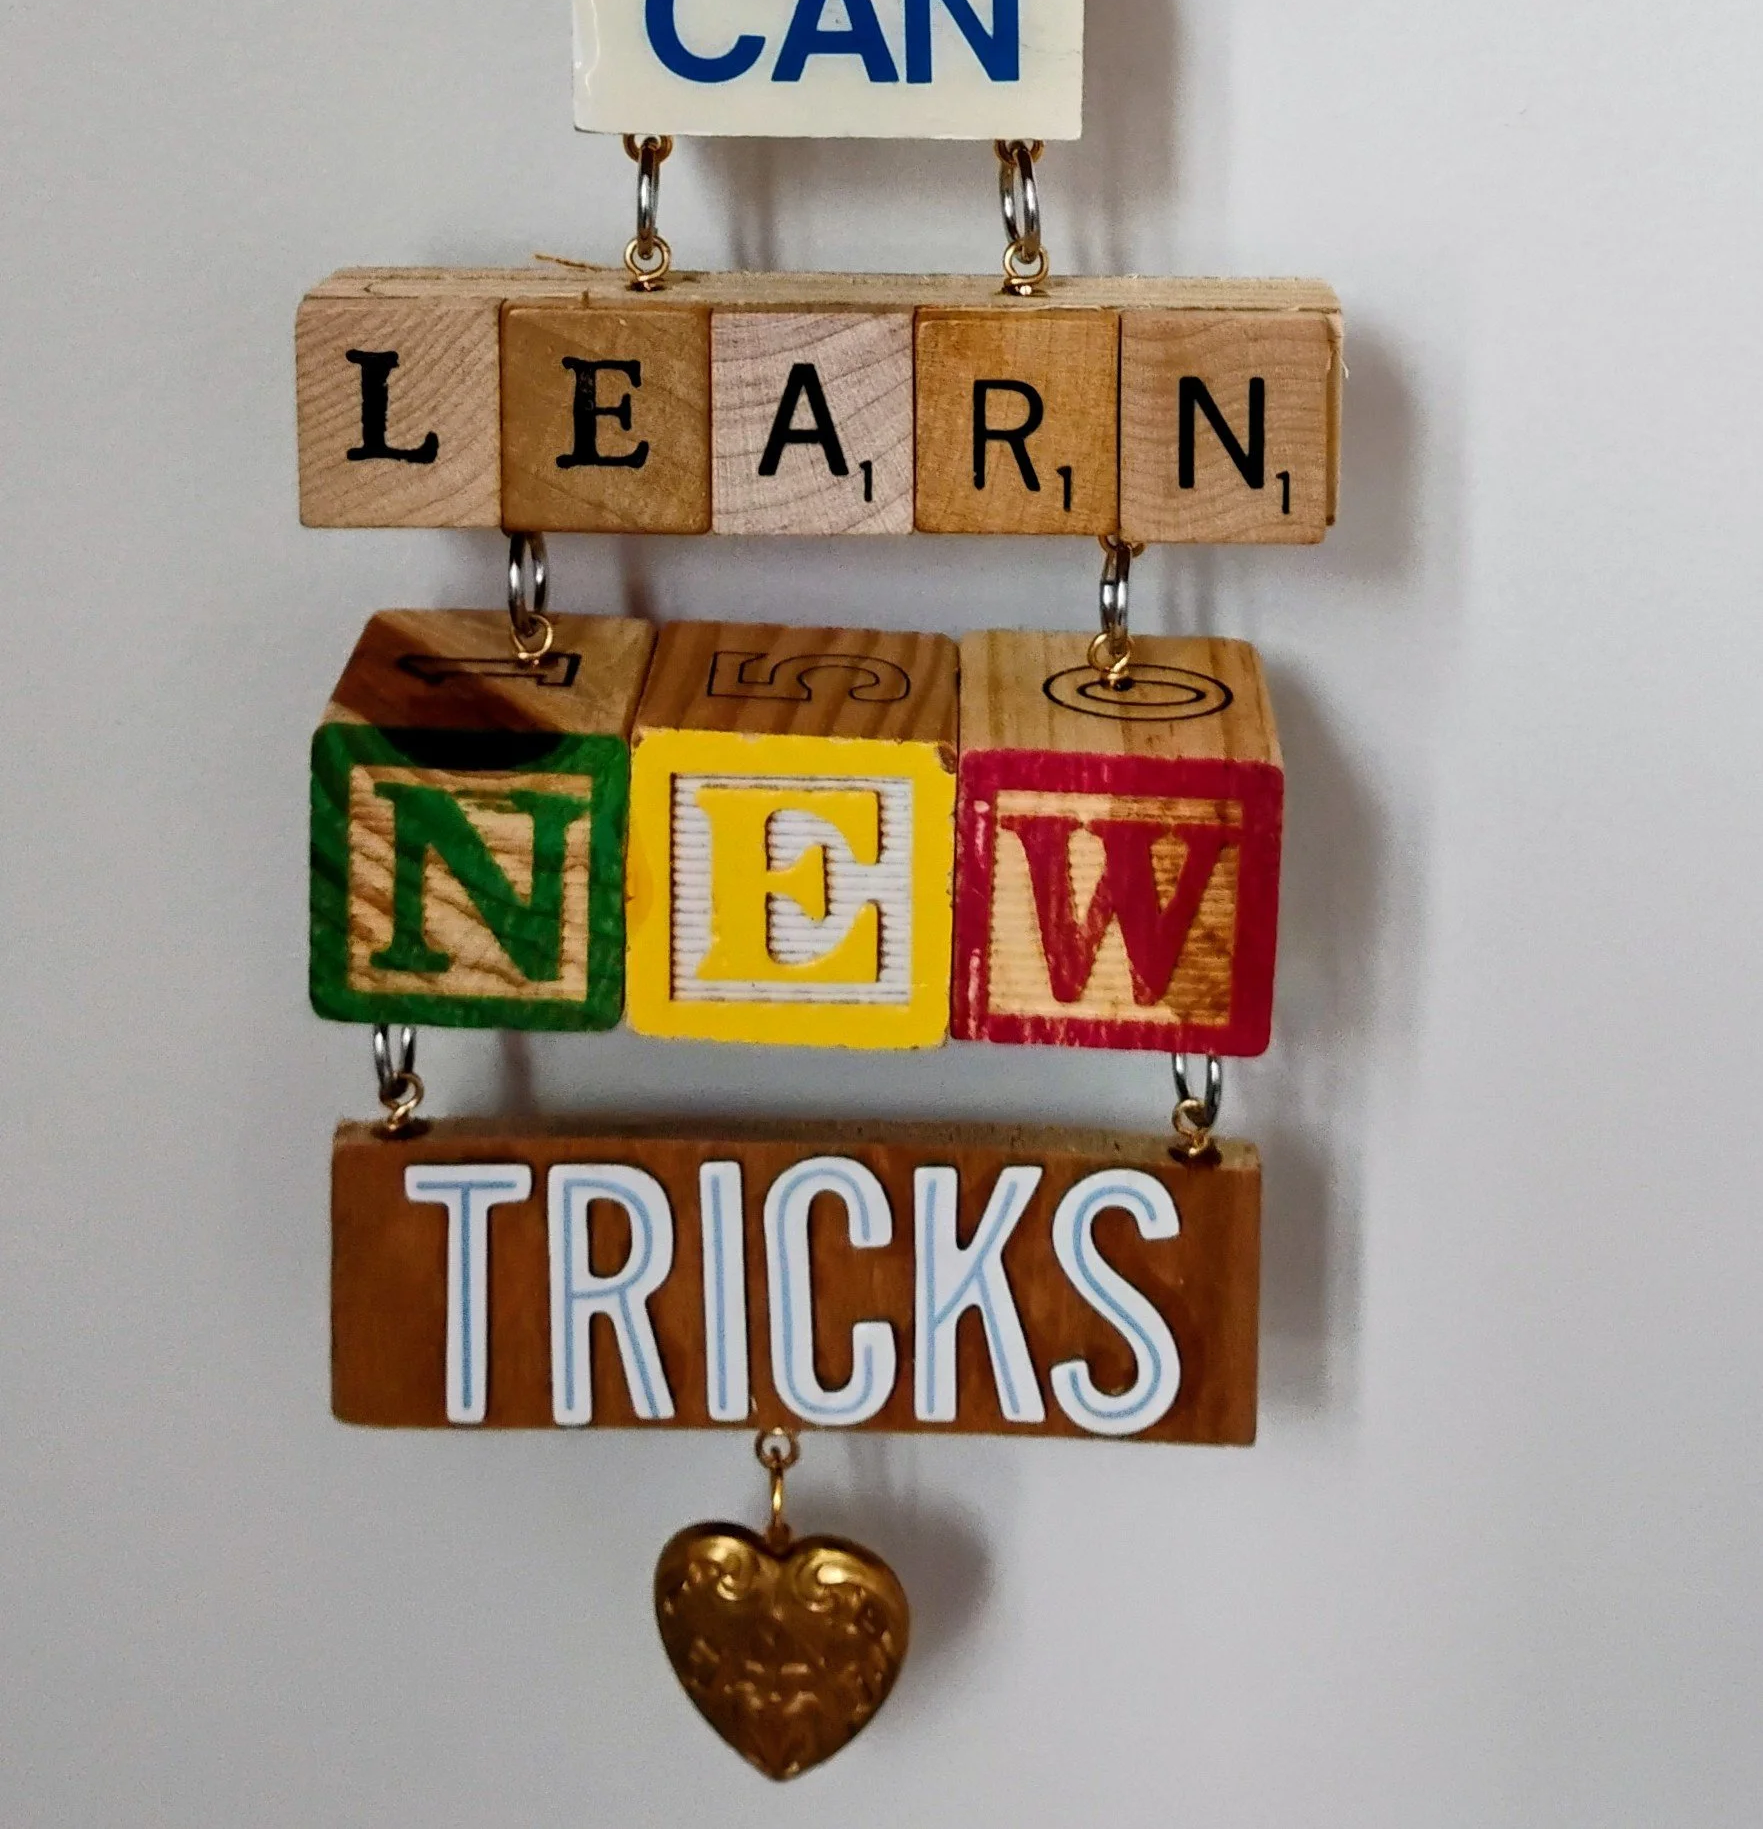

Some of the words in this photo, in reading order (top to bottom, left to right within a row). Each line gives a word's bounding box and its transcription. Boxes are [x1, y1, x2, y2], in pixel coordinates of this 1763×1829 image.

[345, 348, 1265, 490] LEARN
[858, 460, 873, 502] 1
[1055, 466, 1072, 512] 1
[1275, 471, 1290, 515] 1
[708, 649, 912, 703] 5
[374, 779, 1240, 1005] NEW
[404, 1155, 1182, 1435] TRICKS
